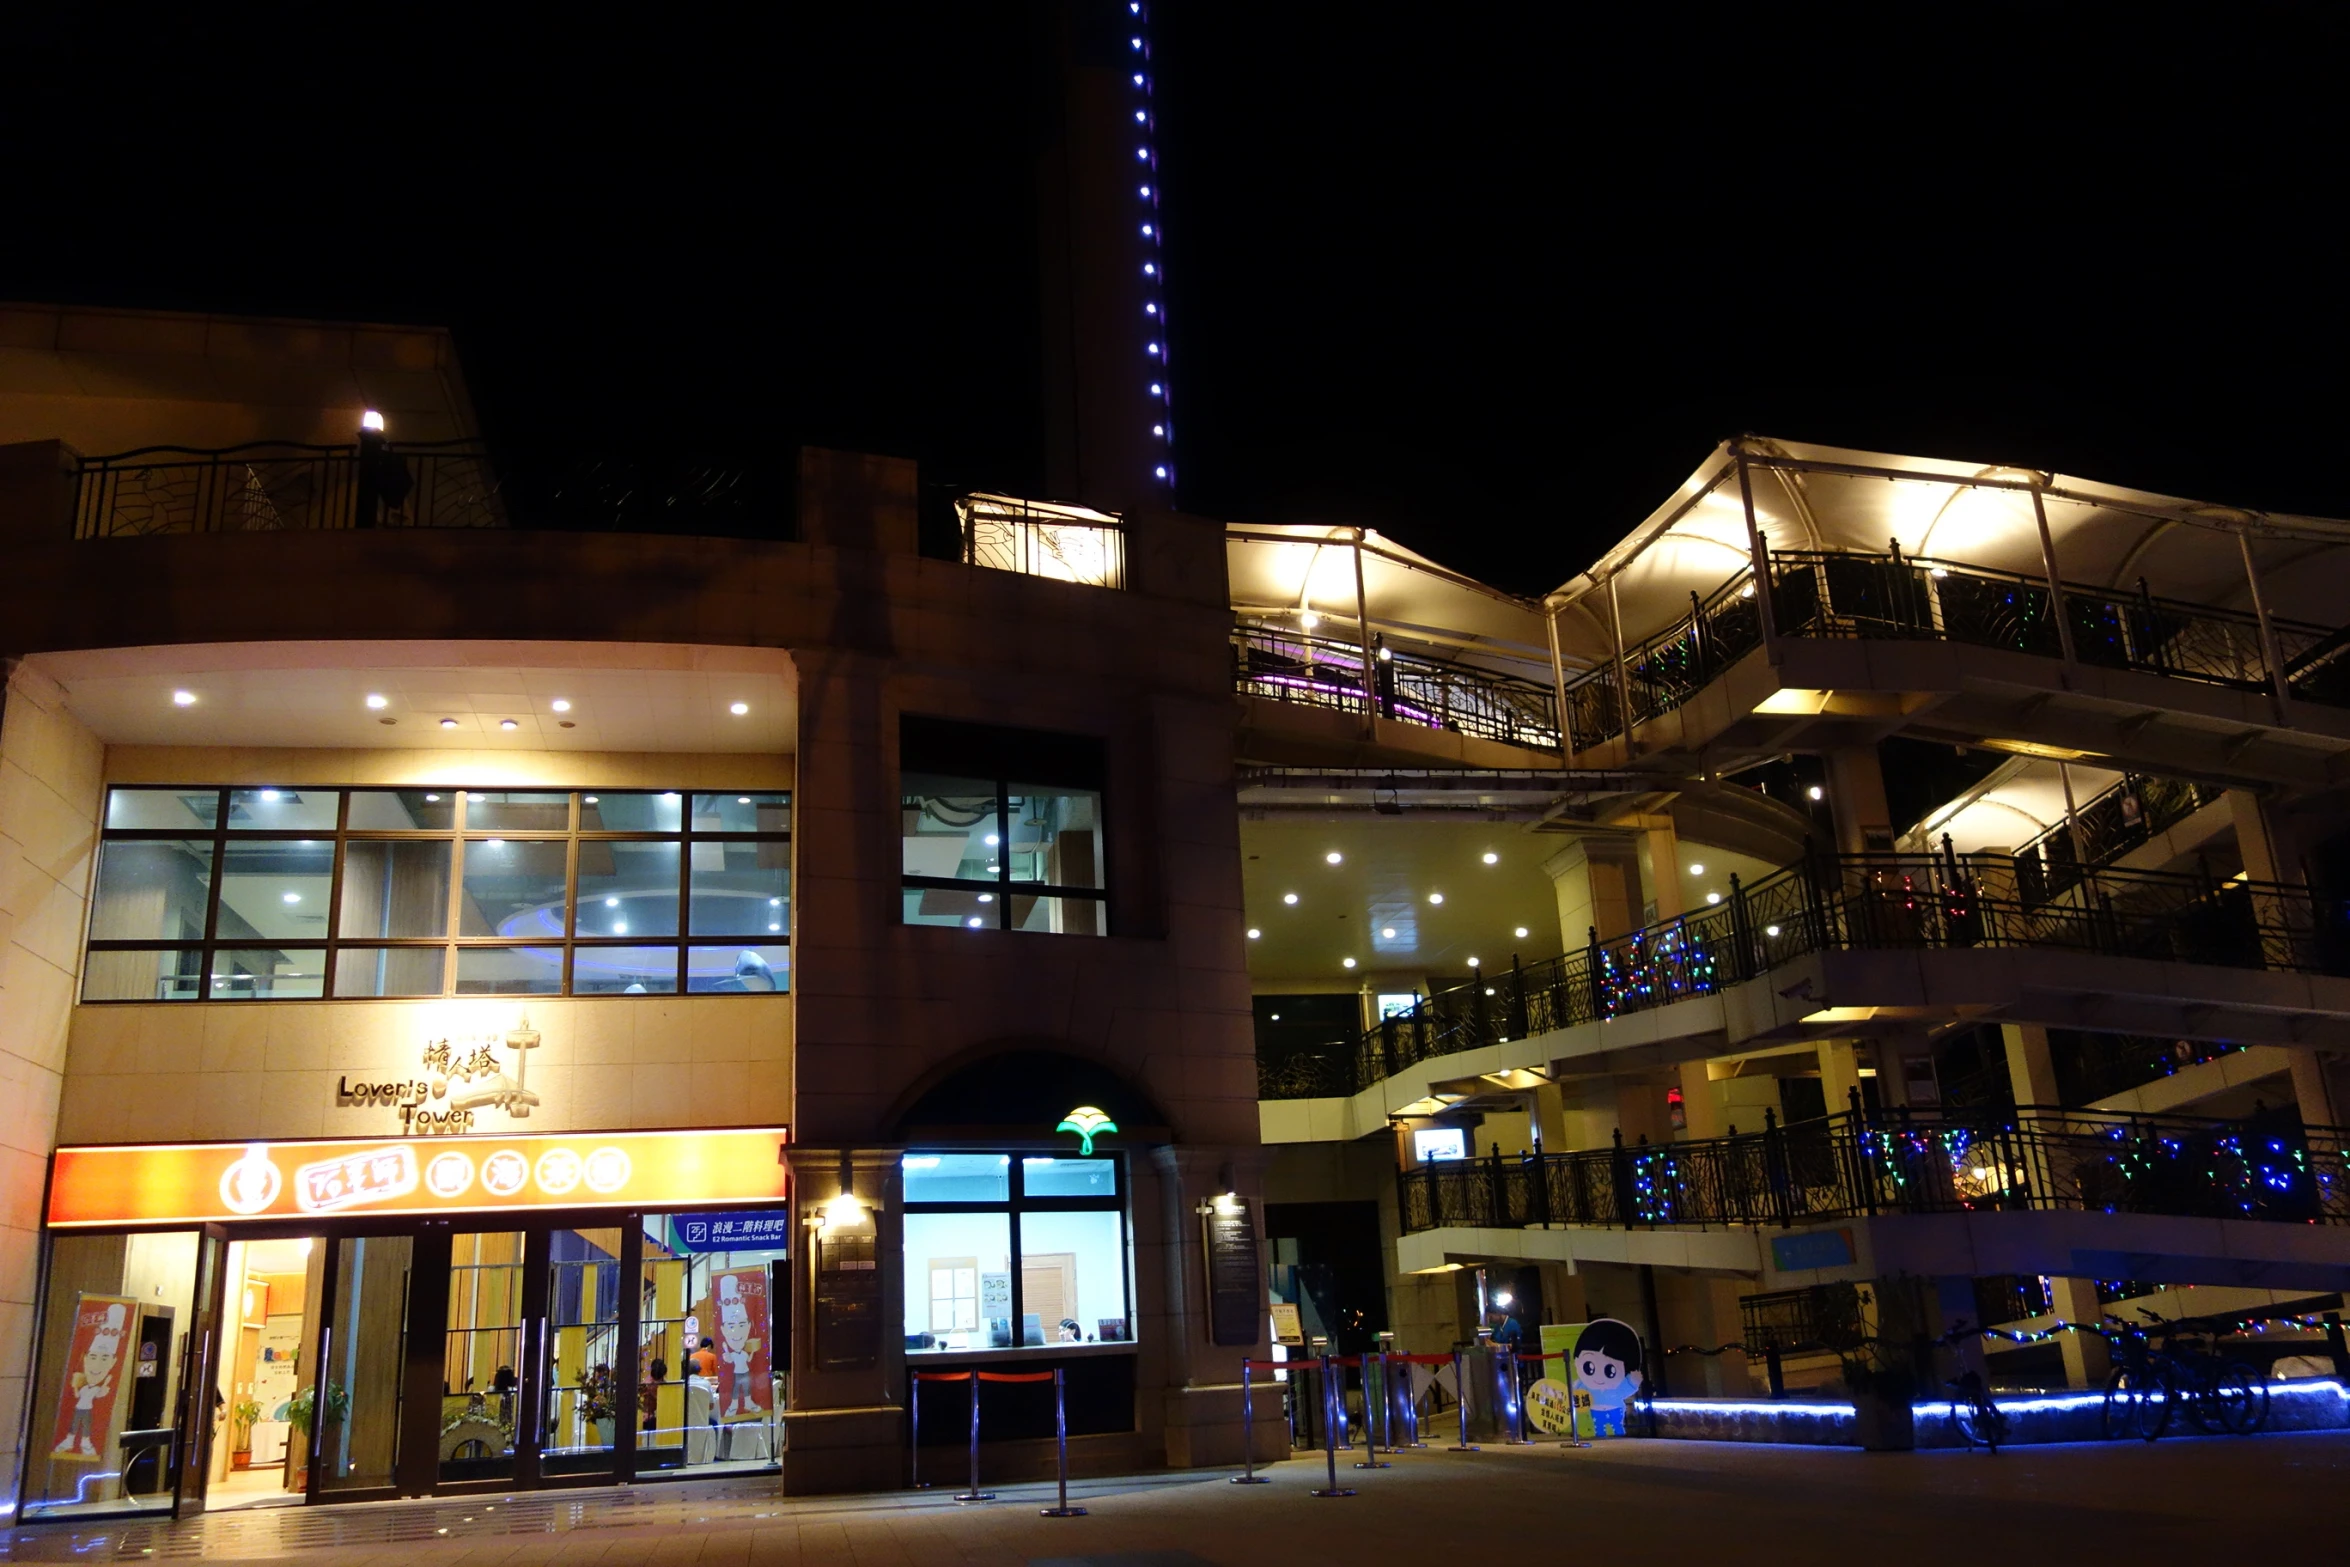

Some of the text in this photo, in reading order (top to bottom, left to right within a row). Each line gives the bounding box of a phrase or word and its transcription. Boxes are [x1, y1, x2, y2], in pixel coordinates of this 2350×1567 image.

[425, 1038, 500, 1073] 情人塔
[340, 1076, 429, 1098] Lover's
[401, 1103, 474, 1125] Tower
[691, 1225, 701, 1234] 2F
[712, 1219, 784, 1234] 浪漫二階料理吧
[721, 1234, 750, 1243] Romantic
